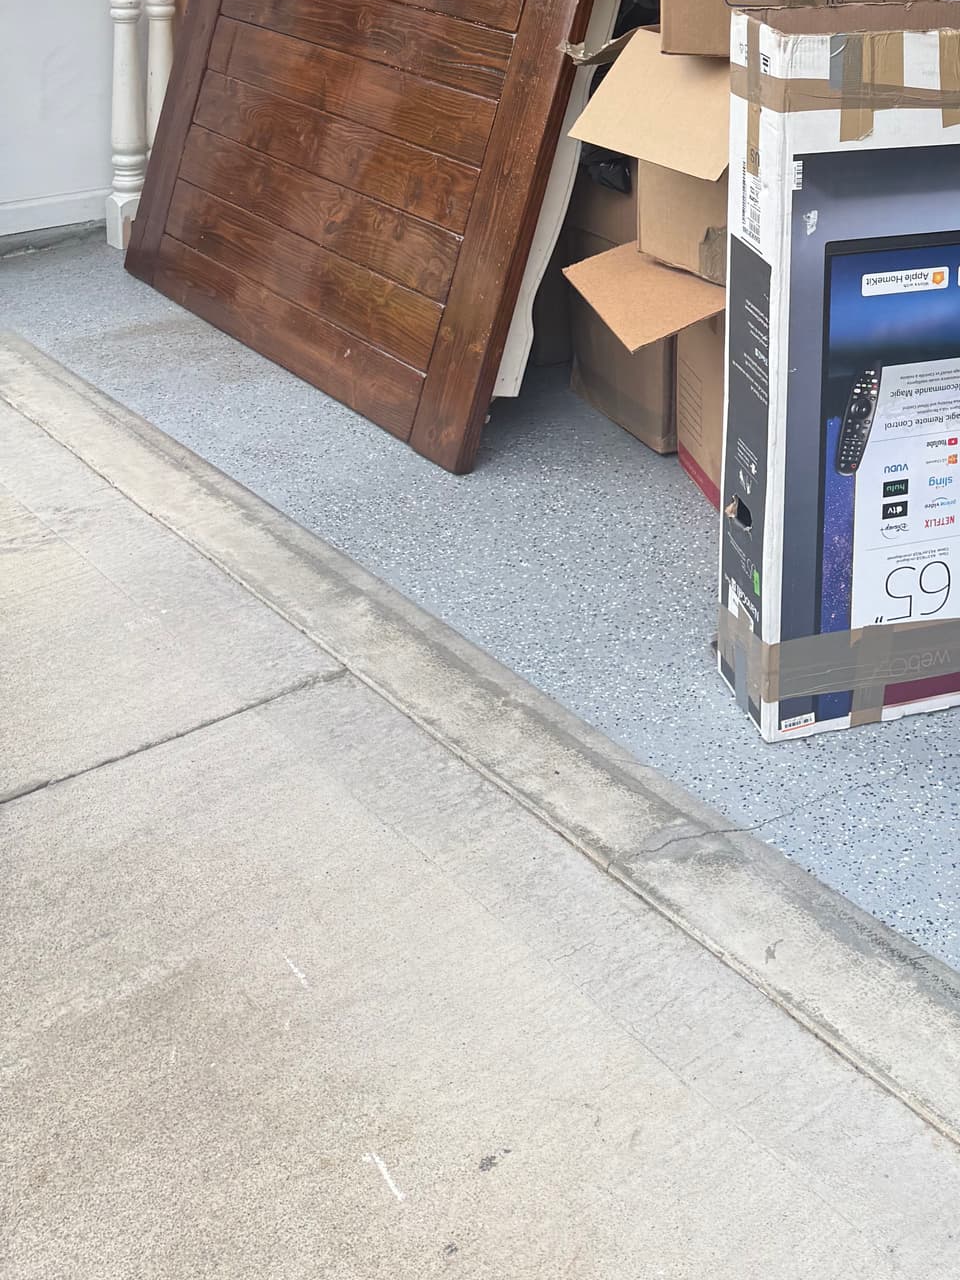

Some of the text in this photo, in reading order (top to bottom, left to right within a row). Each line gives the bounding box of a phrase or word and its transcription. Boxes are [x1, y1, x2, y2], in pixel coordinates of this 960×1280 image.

[866, 271, 928, 286] Apple HomeKit
[890, 388, 912, 398] Magic
[884, 420, 913, 430] Control
[914, 416, 944, 424] Remote
[926, 438, 947, 448] YouTube
[884, 464, 908, 474] VUDU
[928, 476, 952, 487] sling
[886, 483, 905, 492] hulu
[924, 515, 955, 528] NETFLIX
[873, 648, 952, 678] webO
